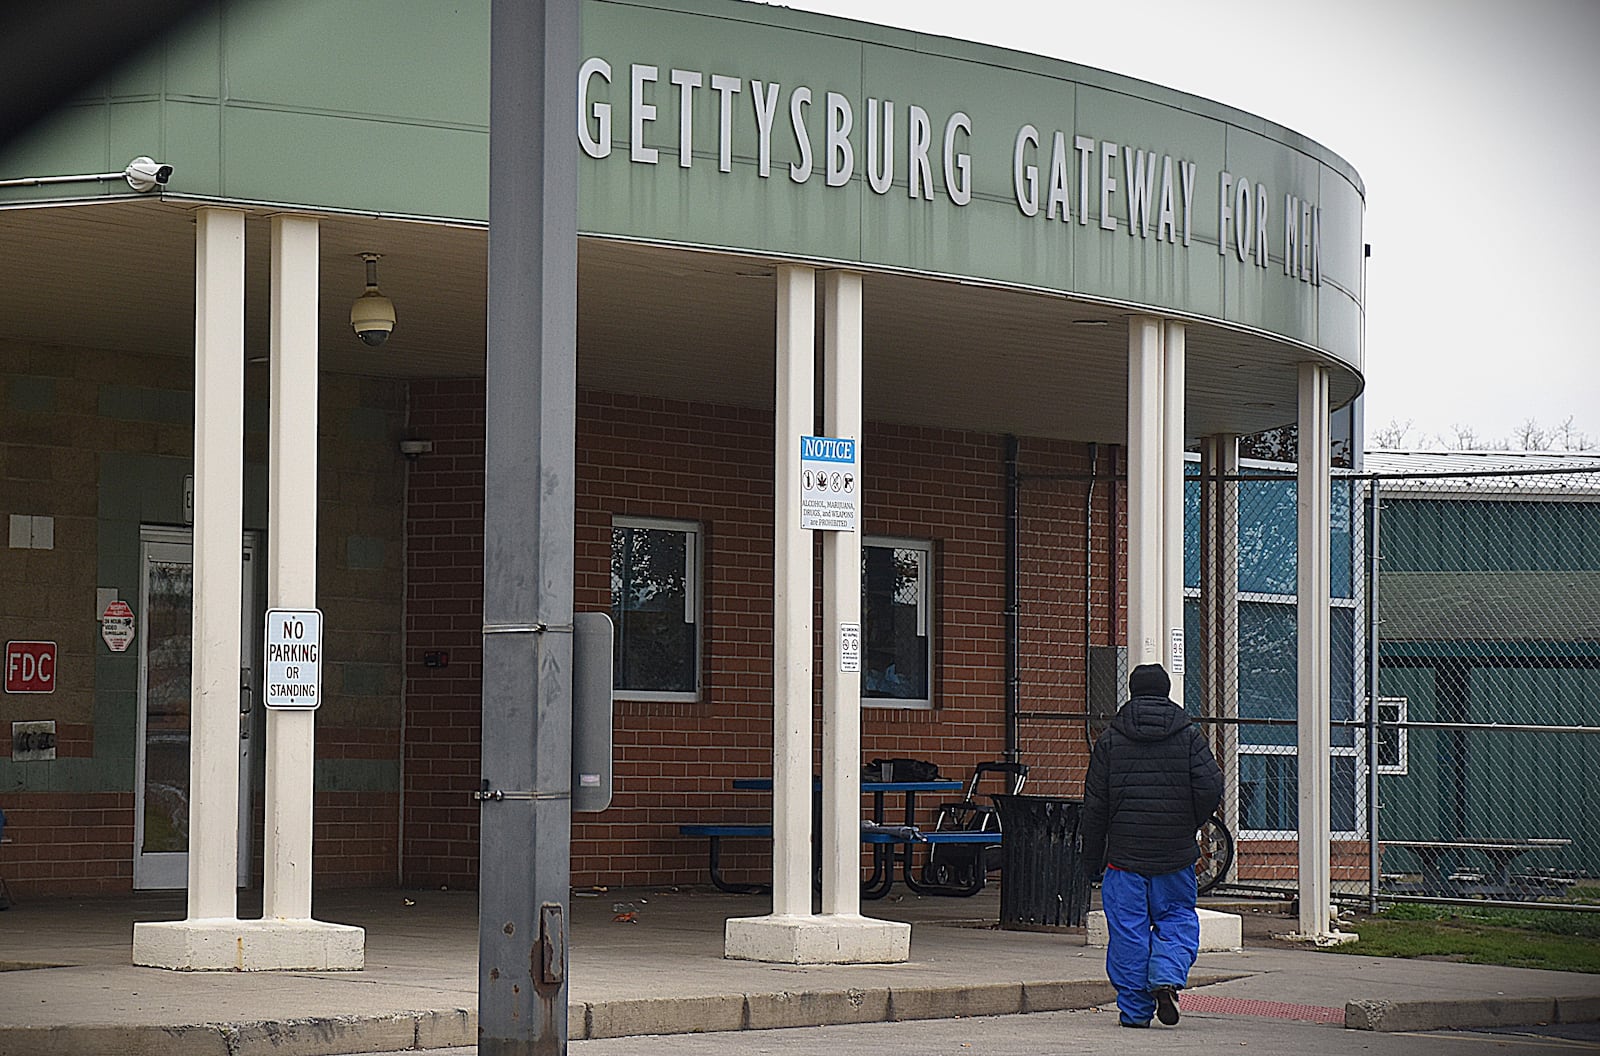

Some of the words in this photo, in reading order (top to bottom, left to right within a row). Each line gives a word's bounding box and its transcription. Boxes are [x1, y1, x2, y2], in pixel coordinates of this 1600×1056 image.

[577, 57, 972, 206] GETTYSBURG
[1013, 124, 1196, 247] GATEWAY
[1219, 170, 1268, 268] FOR
[1284, 193, 1323, 288] MEN
[804, 439, 852, 459] NOTICE
[802, 499, 826, 509] ALCOHOL,
[827, 501, 855, 510] MARIJUANA,
[803, 508, 821, 517] DRUGS,
[822, 509, 831, 517] and
[831, 510, 854, 518] WEAPONS
[818, 518, 847, 527] PROHIBITED
[283, 621, 304, 639] NO
[269, 644, 317, 663] PARKING
[8, 652, 52, 682] FDC
[286, 666, 299, 679] OR
[270, 684, 315, 697] STANDING
